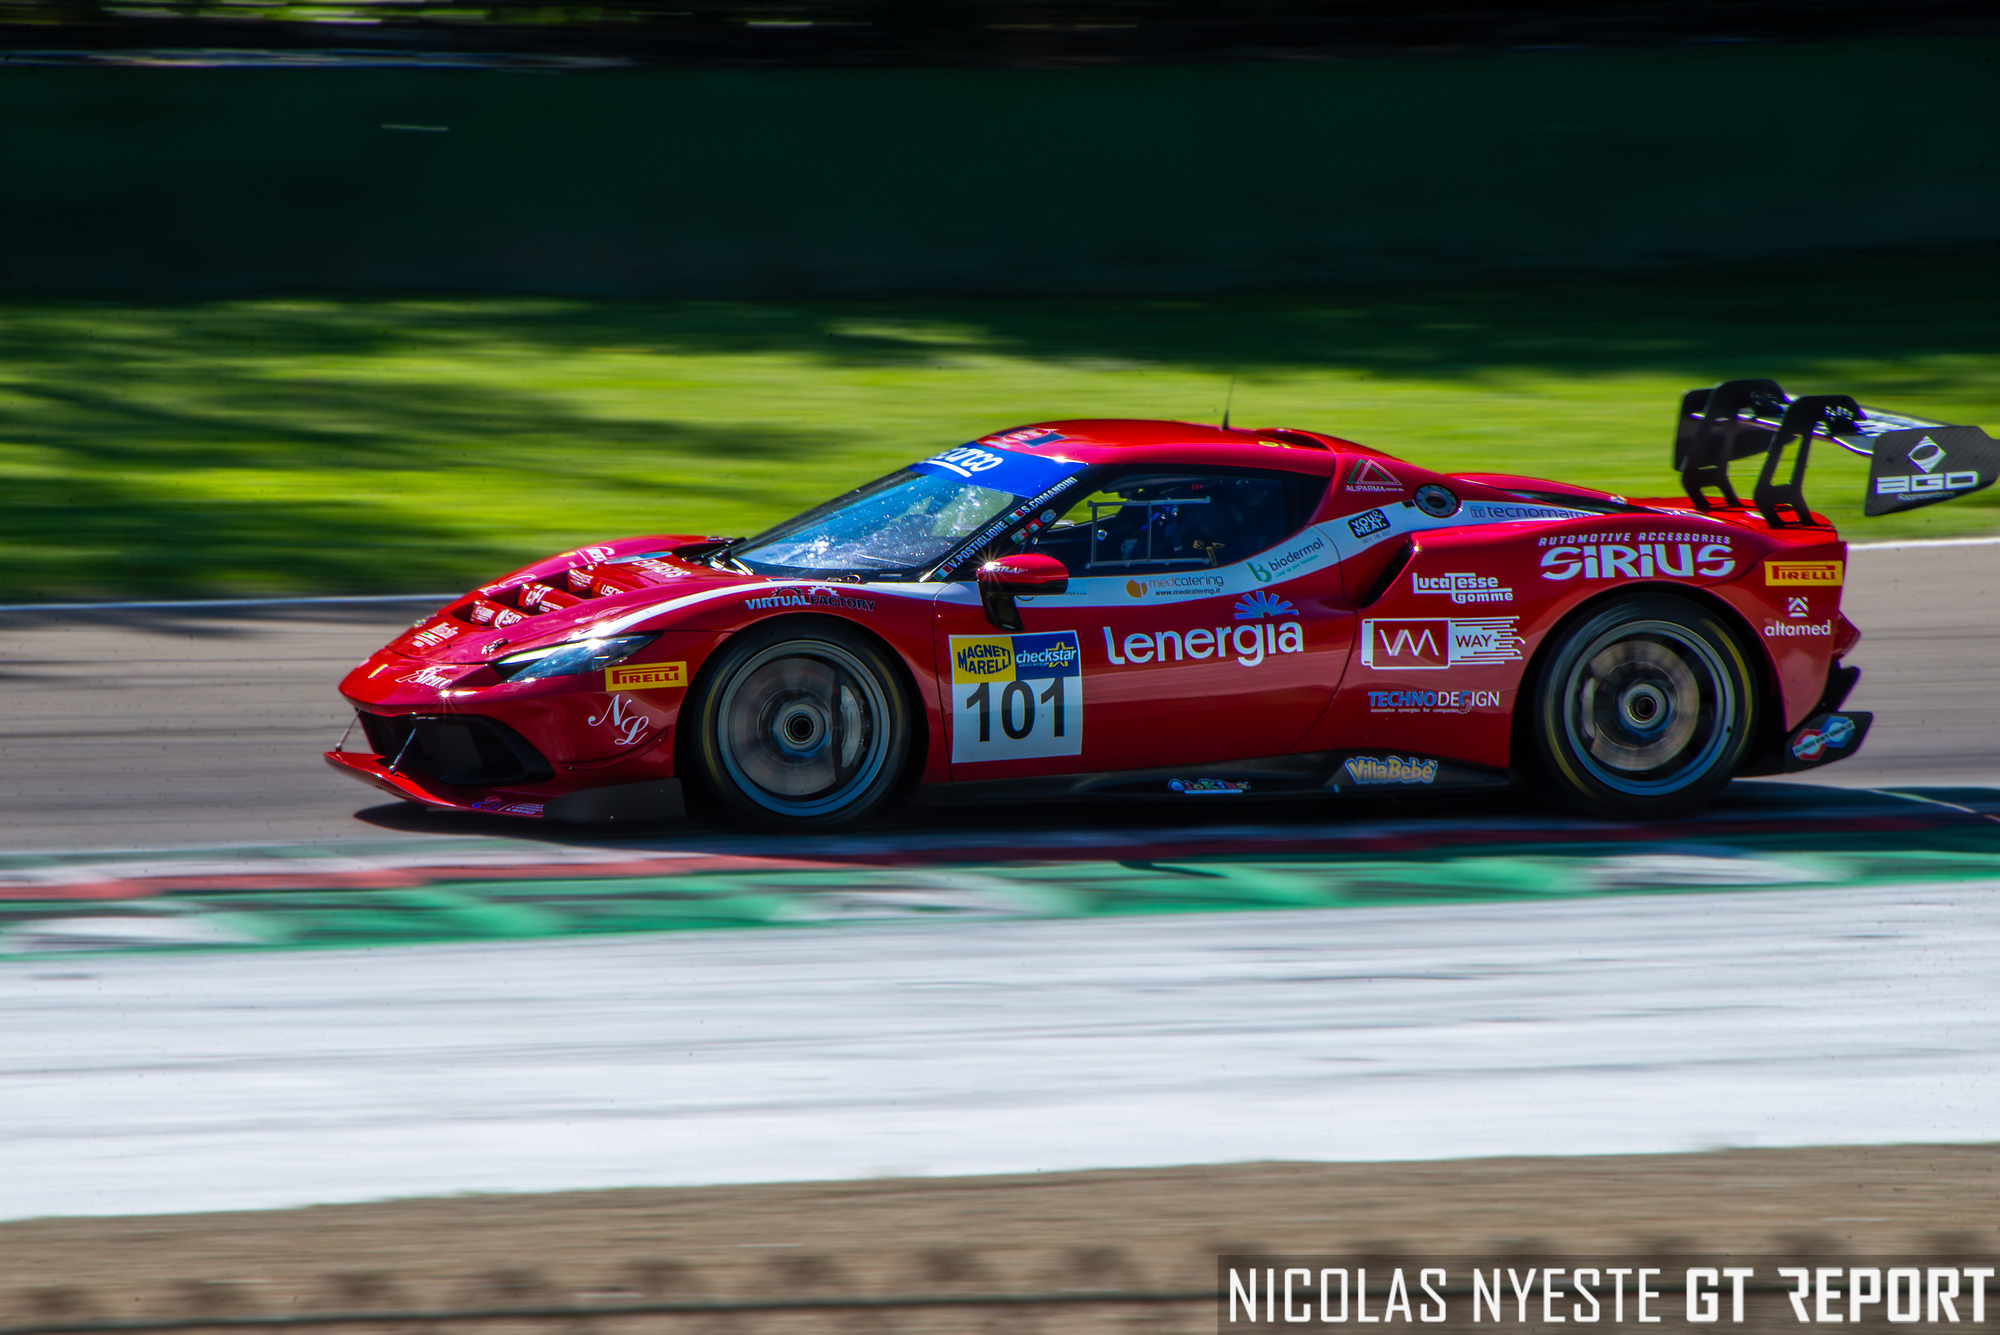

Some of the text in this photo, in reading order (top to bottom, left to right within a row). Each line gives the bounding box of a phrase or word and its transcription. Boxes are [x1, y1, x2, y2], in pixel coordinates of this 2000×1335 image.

[1020, 476, 1079, 514] S.COMANDINI
[947, 520, 1009, 570] V.POSTIGLIONE
[1538, 532, 1731, 546] AUTOMOTIVE ACCESSORIES
[1268, 537, 1325, 571] biodermol
[1772, 565, 1836, 580] PIRELLI
[1148, 575, 1223, 588] medcatering
[1155, 587, 1220, 596] www.medcatering.it
[1456, 592, 1513, 604] gomme
[1764, 619, 1831, 636] altamed
[1455, 634, 1493, 648] WAY
[957, 644, 1011, 661] MAGNETI
[1016, 648, 1077, 664] checkstar
[958, 657, 1011, 675] MARELLI
[612, 666, 680, 685] PIRELLI
[966, 677, 1065, 743] 101
